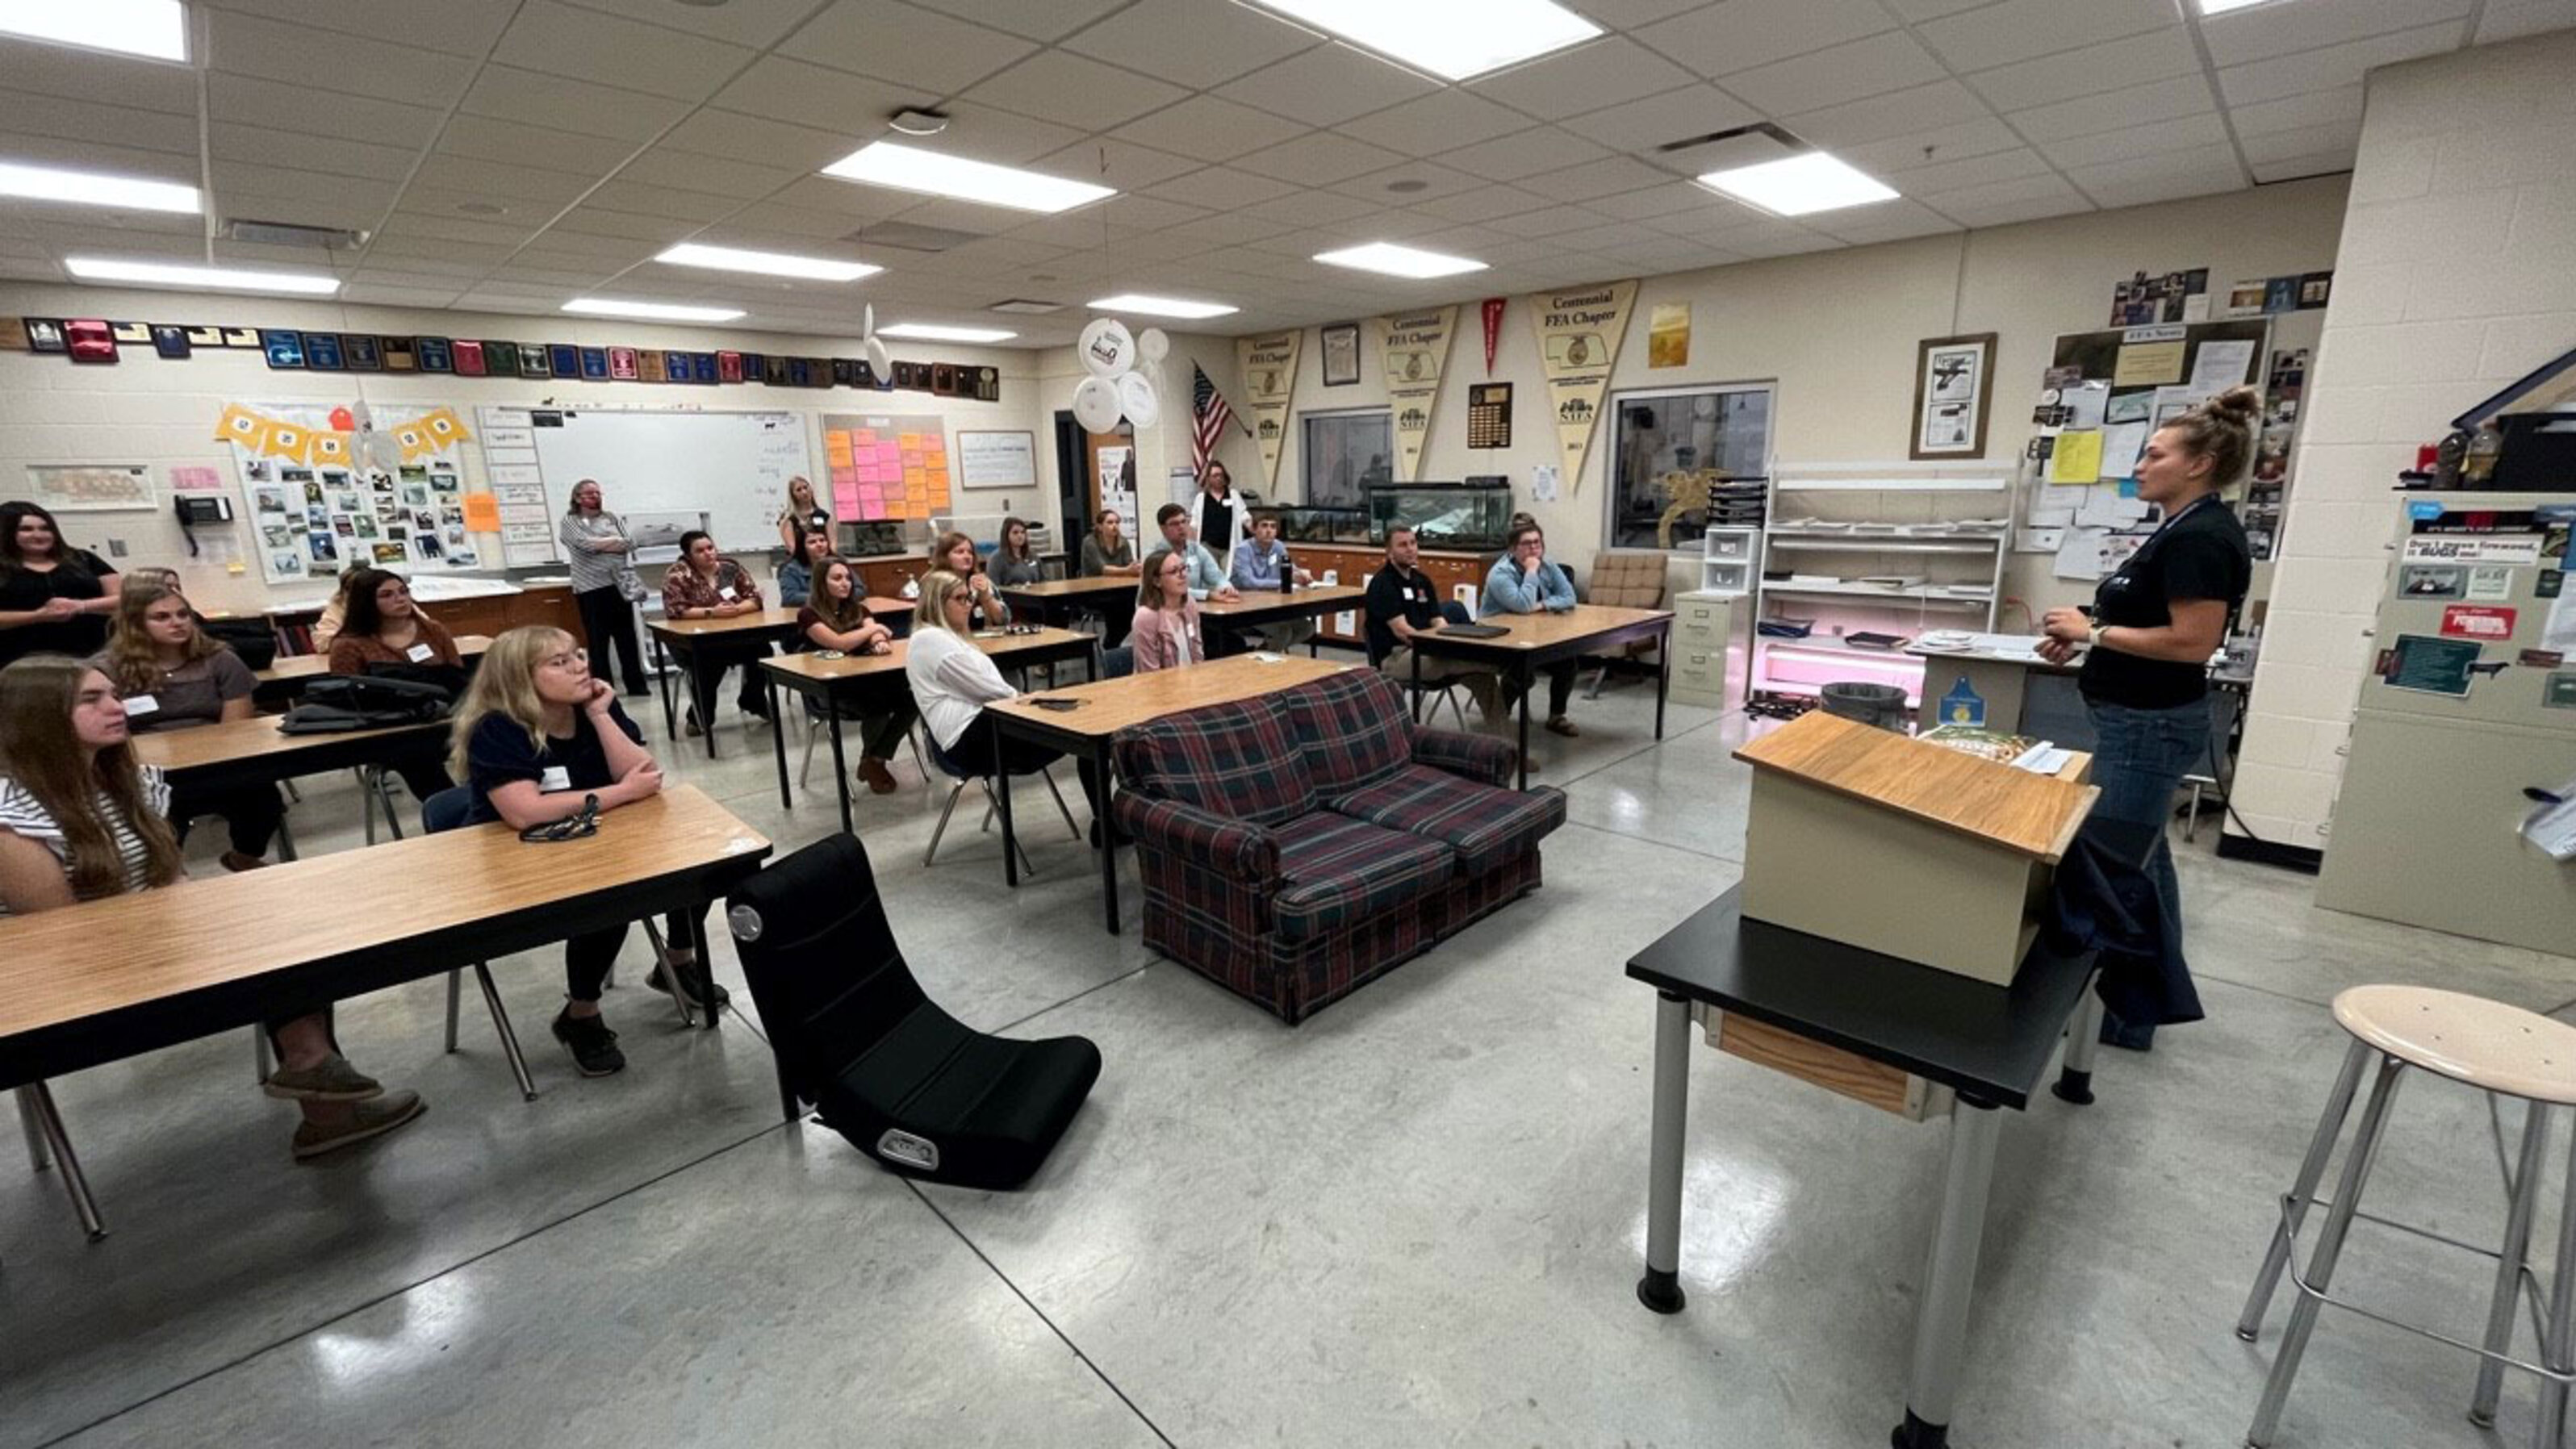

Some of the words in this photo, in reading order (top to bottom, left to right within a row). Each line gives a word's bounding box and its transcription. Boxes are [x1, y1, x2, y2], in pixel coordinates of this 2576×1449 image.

[1553, 289, 1613, 310] Centennial
[1393, 314, 1440, 331] Centennial
[1545, 313, 1569, 327] FFA
[1572, 311, 1616, 326] Chapter
[2419, 546, 2459, 557] BUGS
